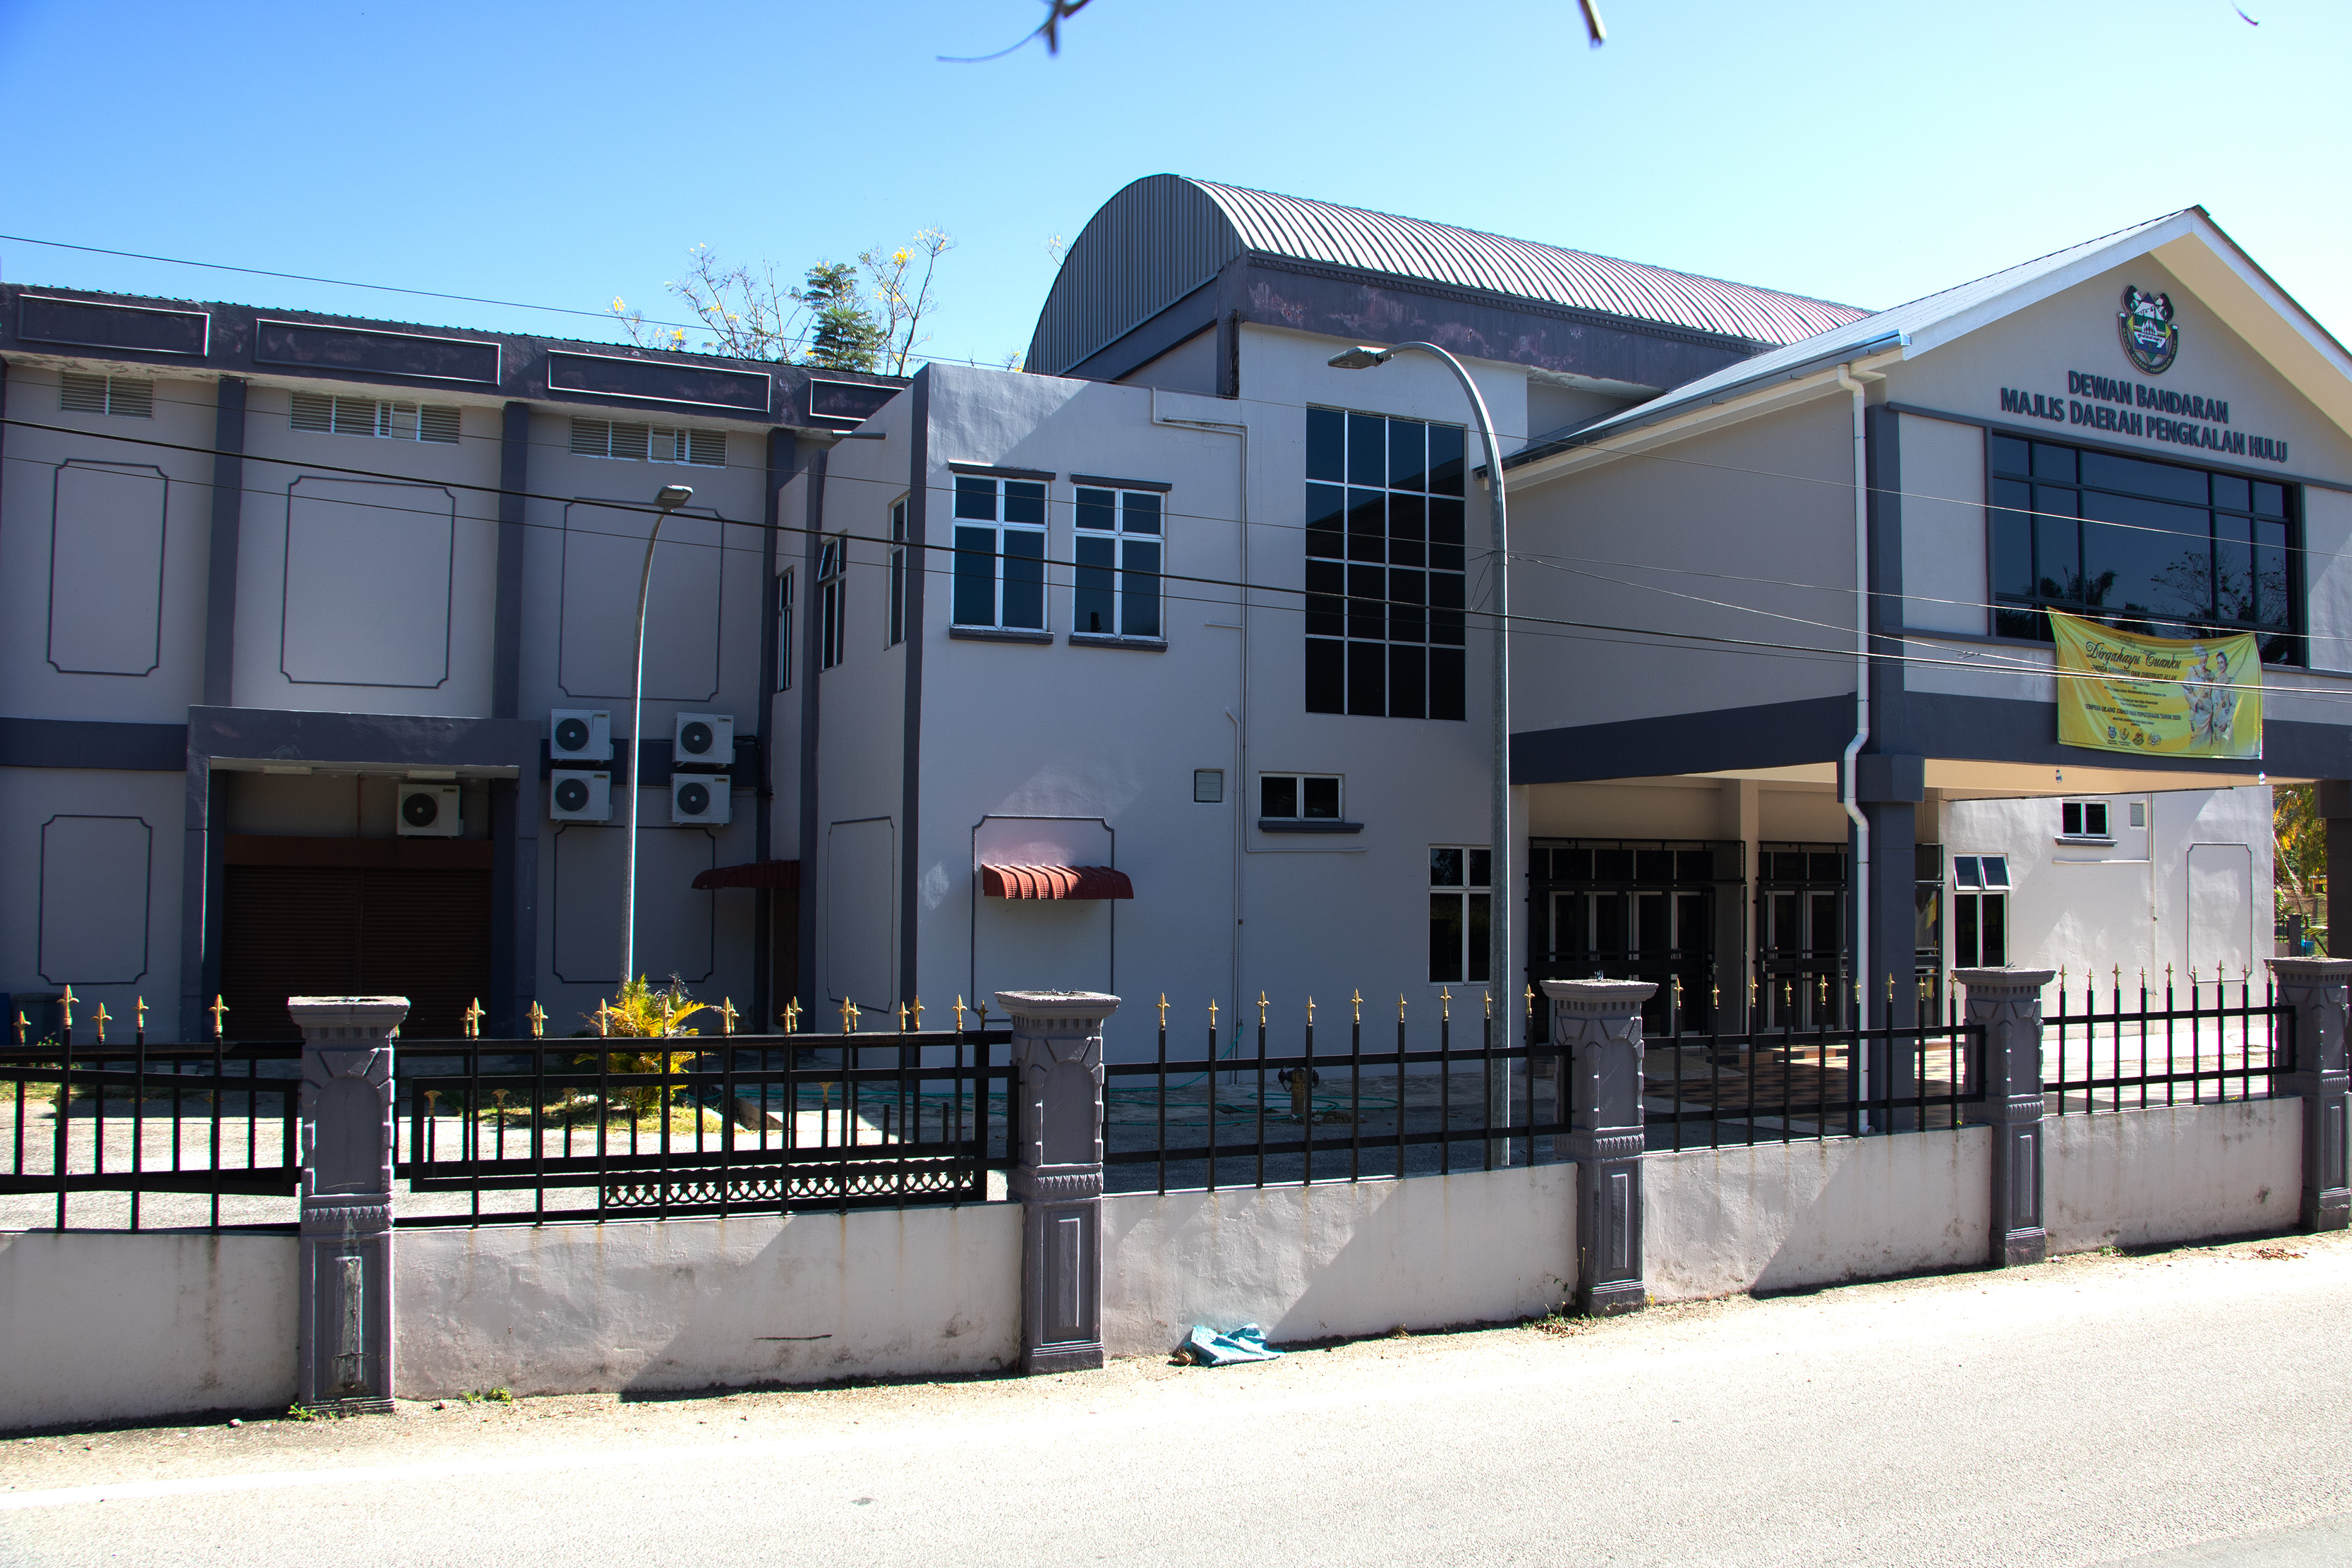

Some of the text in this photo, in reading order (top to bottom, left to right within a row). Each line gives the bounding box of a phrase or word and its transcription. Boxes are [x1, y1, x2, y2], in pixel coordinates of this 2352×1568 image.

[2068, 370, 2229, 424] DEWAN BANDARAN
[2001, 387, 2287, 463] MAJLIS DAERAH PENGKALAN HULU
[2085, 641, 2141, 670] Dirgahayu
[2140, 649, 2181, 670] Tuanku
